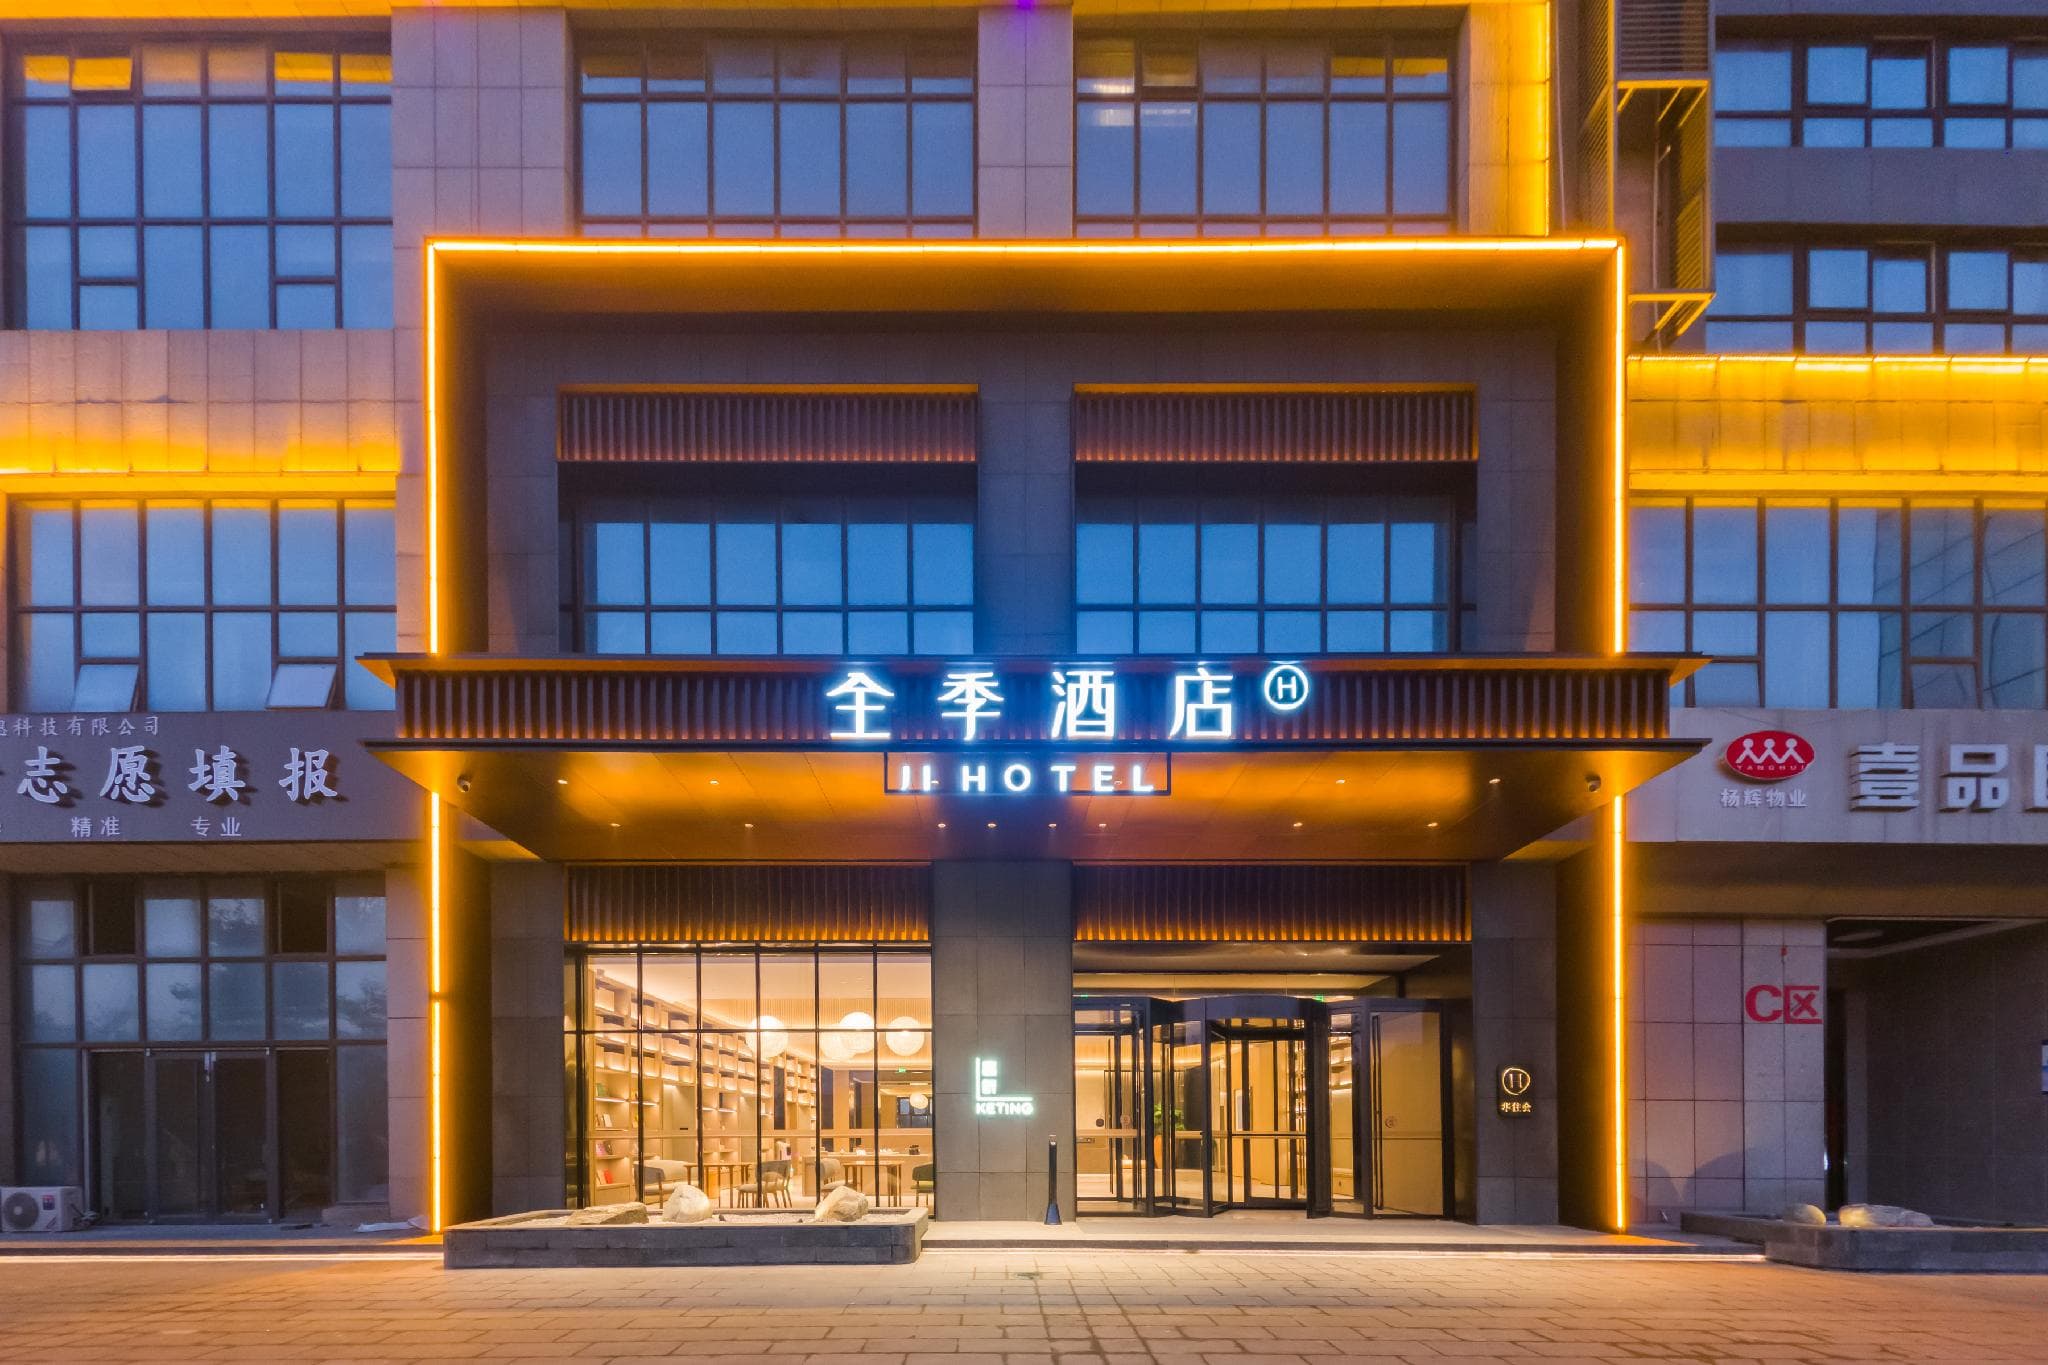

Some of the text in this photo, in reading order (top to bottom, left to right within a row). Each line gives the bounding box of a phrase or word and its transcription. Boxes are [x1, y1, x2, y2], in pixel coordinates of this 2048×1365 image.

[826, 668, 1233, 740] 全季酒店
[17, 745, 338, 804] 志愿填报
[900, 764, 1154, 792] JI HOTEL
[1856, 742, 2048, 809] 壹品
[1720, 788, 1808, 808] 杨辉物业
[71, 816, 242, 838] 精准 专业
[1745, 984, 1824, 1024] C区
